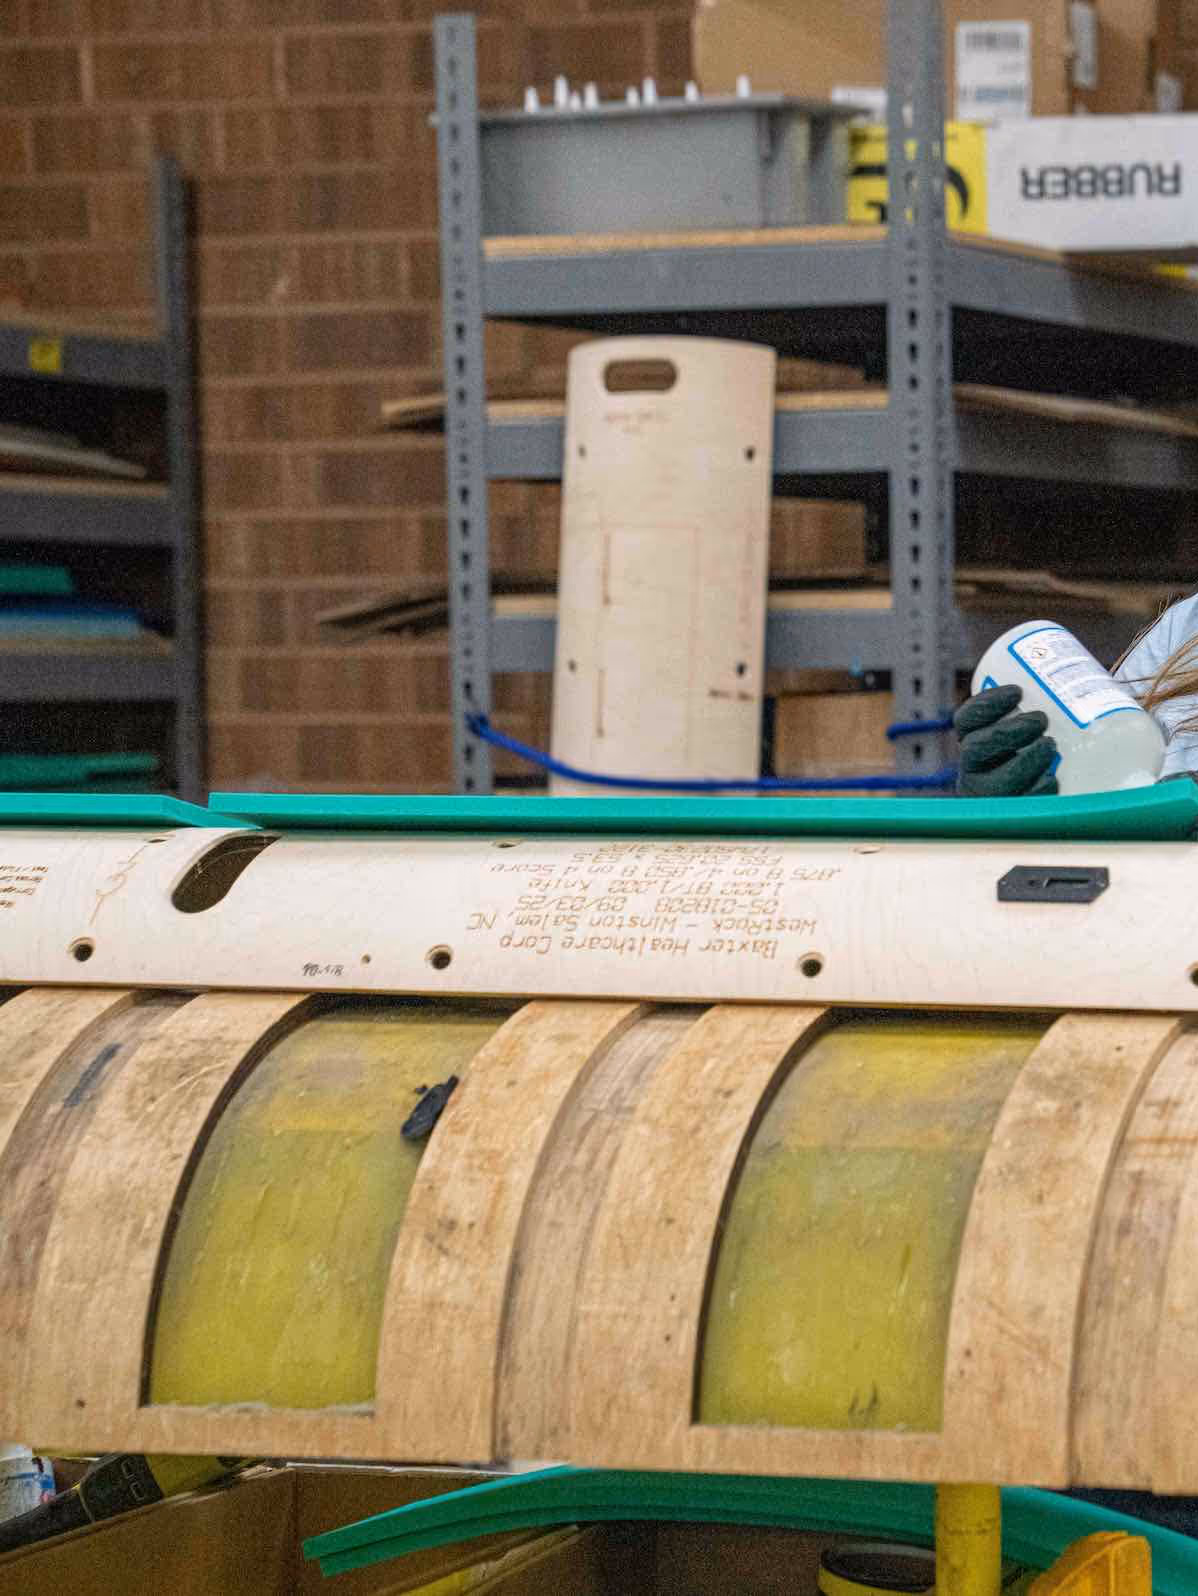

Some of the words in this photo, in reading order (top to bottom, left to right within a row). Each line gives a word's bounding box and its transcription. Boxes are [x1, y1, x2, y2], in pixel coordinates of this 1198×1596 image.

[1020, 163, 1182, 200] RUBBER
[489, 863, 557, 876] Score
[587, 864, 614, 874] on
[732, 867, 759, 877] on
[528, 879, 593, 892] Knife
[466, 912, 497, 930] NC
[507, 911, 580, 932] Salem,
[590, 914, 678, 933] Winston
[712, 917, 817, 935] WestRock
[500, 930, 552, 954] Corp
[561, 936, 690, 956] Healthcare
[698, 938, 778, 959] Baxter
